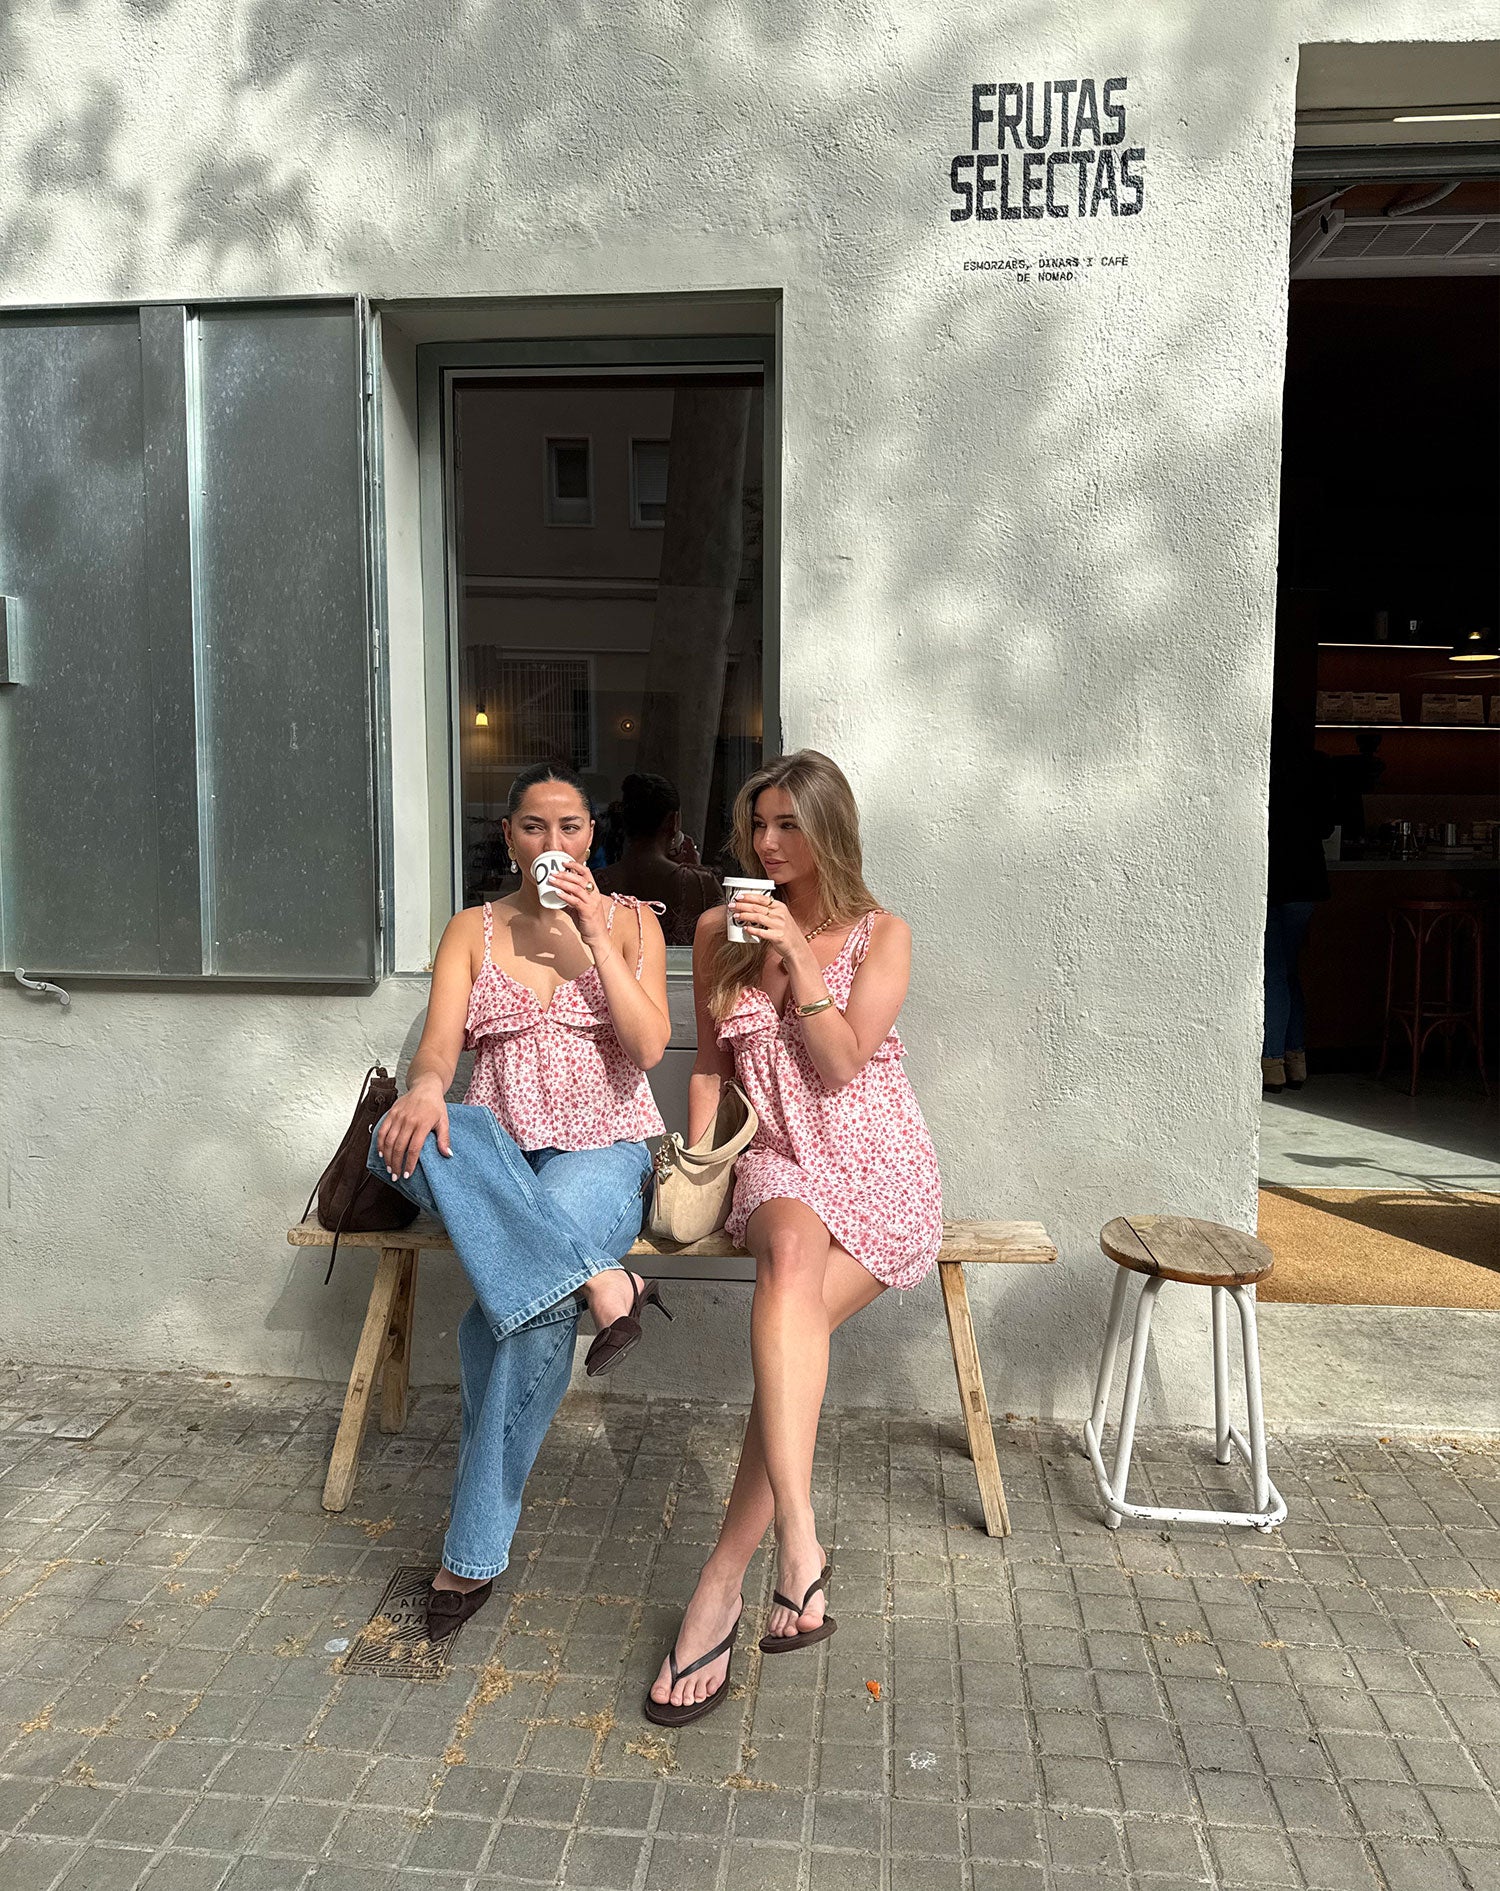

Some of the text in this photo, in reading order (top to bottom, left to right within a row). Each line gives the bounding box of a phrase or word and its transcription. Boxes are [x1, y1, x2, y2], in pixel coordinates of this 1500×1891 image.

[971, 77, 1128, 150] FRUTAS
[950, 147, 1146, 222] SELECTAS
[1016, 272, 1030, 282] DE
[1038, 257, 1079, 268] DINARS
[1086, 257, 1094, 267] I
